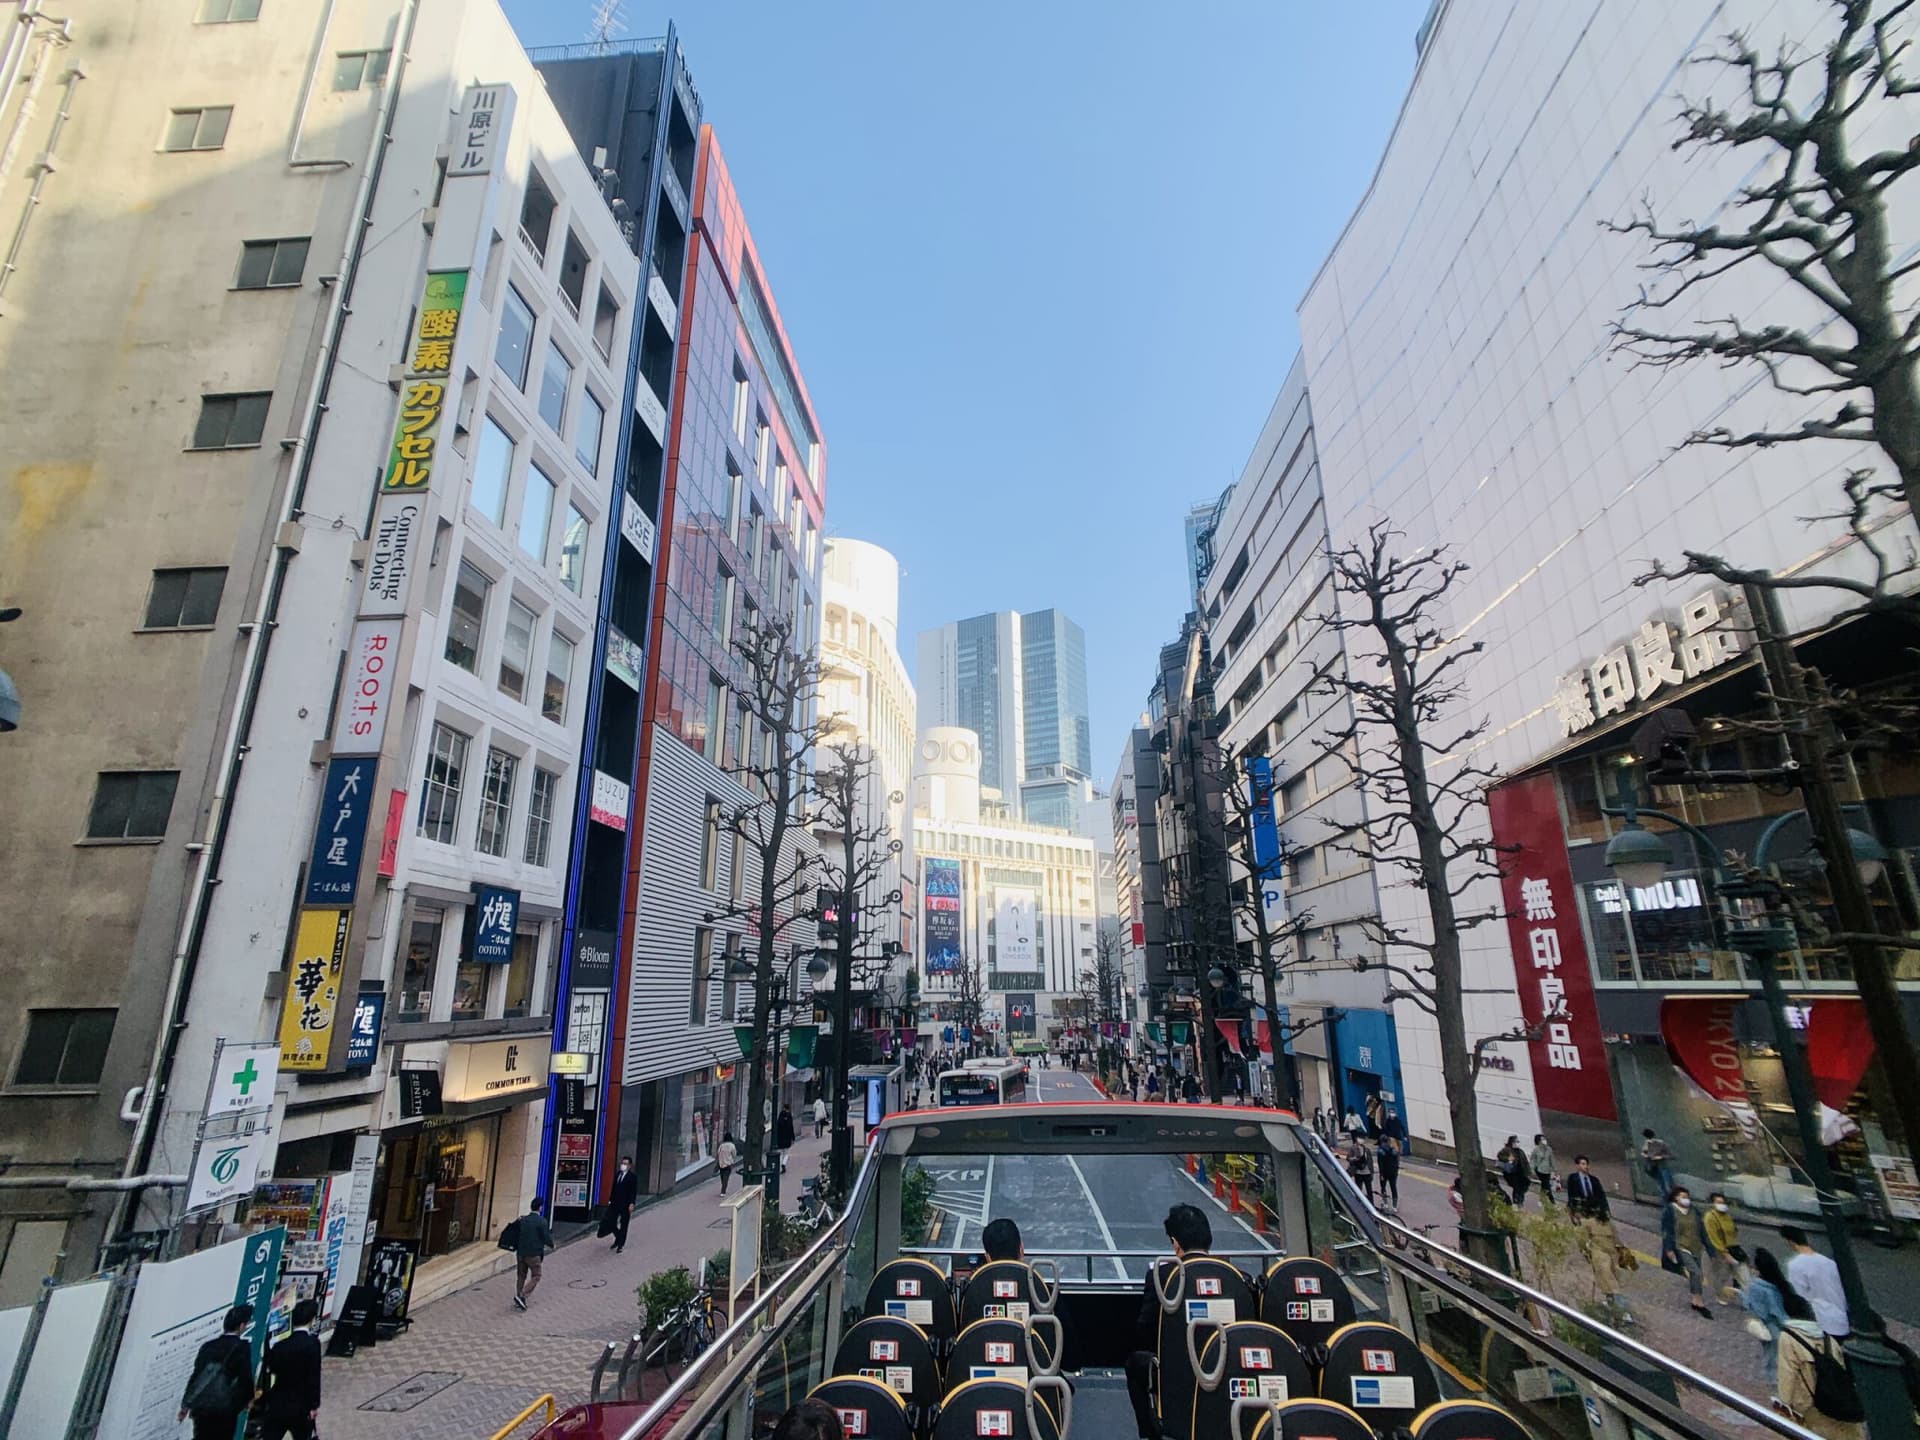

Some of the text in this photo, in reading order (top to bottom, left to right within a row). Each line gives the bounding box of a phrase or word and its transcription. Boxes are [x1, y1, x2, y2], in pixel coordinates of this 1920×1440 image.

[461, 91, 496, 170] 川原ビル
[369, 515, 400, 592] The Dots
[380, 505, 418, 602] Connecting
[1554, 589, 1741, 738] 無印良品
[327, 766, 361, 866] 大戸屋
[1264, 891, 1279, 908] P
[1633, 879, 1702, 911] MUJI
[587, 947, 609, 963] Bloom
[1521, 877, 1583, 1071] 無印良品
[351, 1000, 375, 1035] 戸屋
[411, 1073, 423, 1115] ZENITH
[486, 1076, 532, 1091] COMMON TIME
